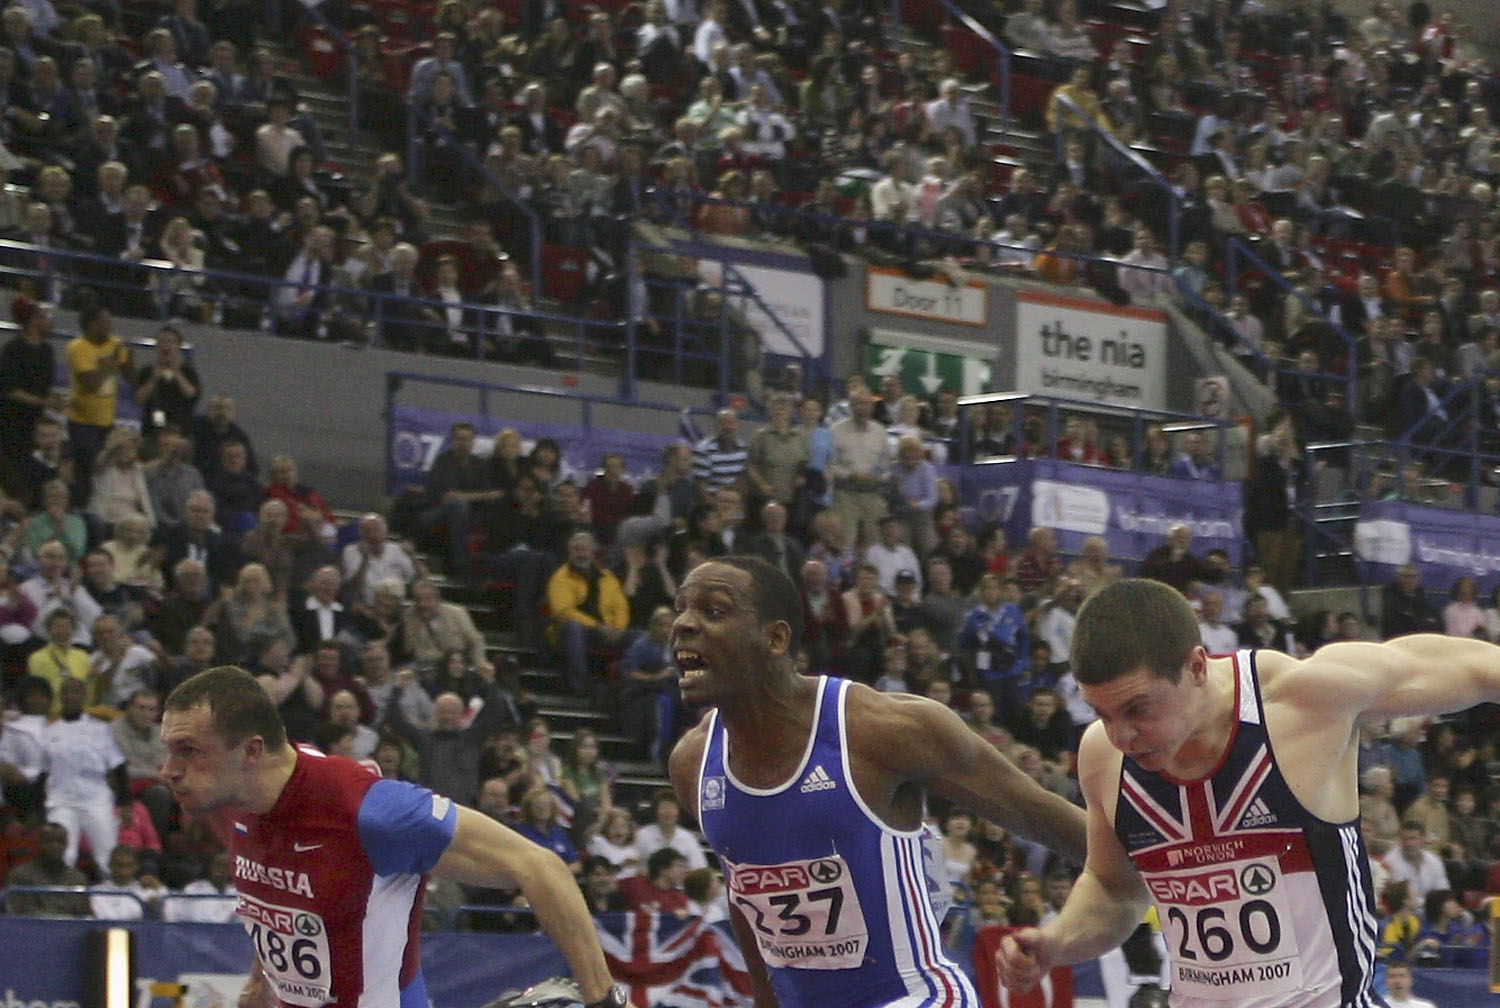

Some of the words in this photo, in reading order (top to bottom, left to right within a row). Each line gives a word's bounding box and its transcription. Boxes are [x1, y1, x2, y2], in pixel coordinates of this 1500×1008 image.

[1040, 320, 1093, 361] the
[1101, 330, 1146, 369] nia
[1042, 369, 1141, 400] birmingham
[393, 431, 444, 472] 07
[801, 779, 836, 794] adidas
[1242, 814, 1278, 828] adidas
[1184, 840, 1244, 857] NORWICH
[1195, 850, 1236, 864] UNION
[235, 855, 315, 899] RUSSIA
[1151, 875, 1237, 901] SPAR
[736, 887, 844, 937] 237
[1168, 899, 1281, 962] 260
[761, 939, 826, 959] BNGHAM
[827, 940, 861, 957] 2007
[1179, 967, 1255, 987] BIRMINGHAM
[1257, 962, 1291, 982] 2007
